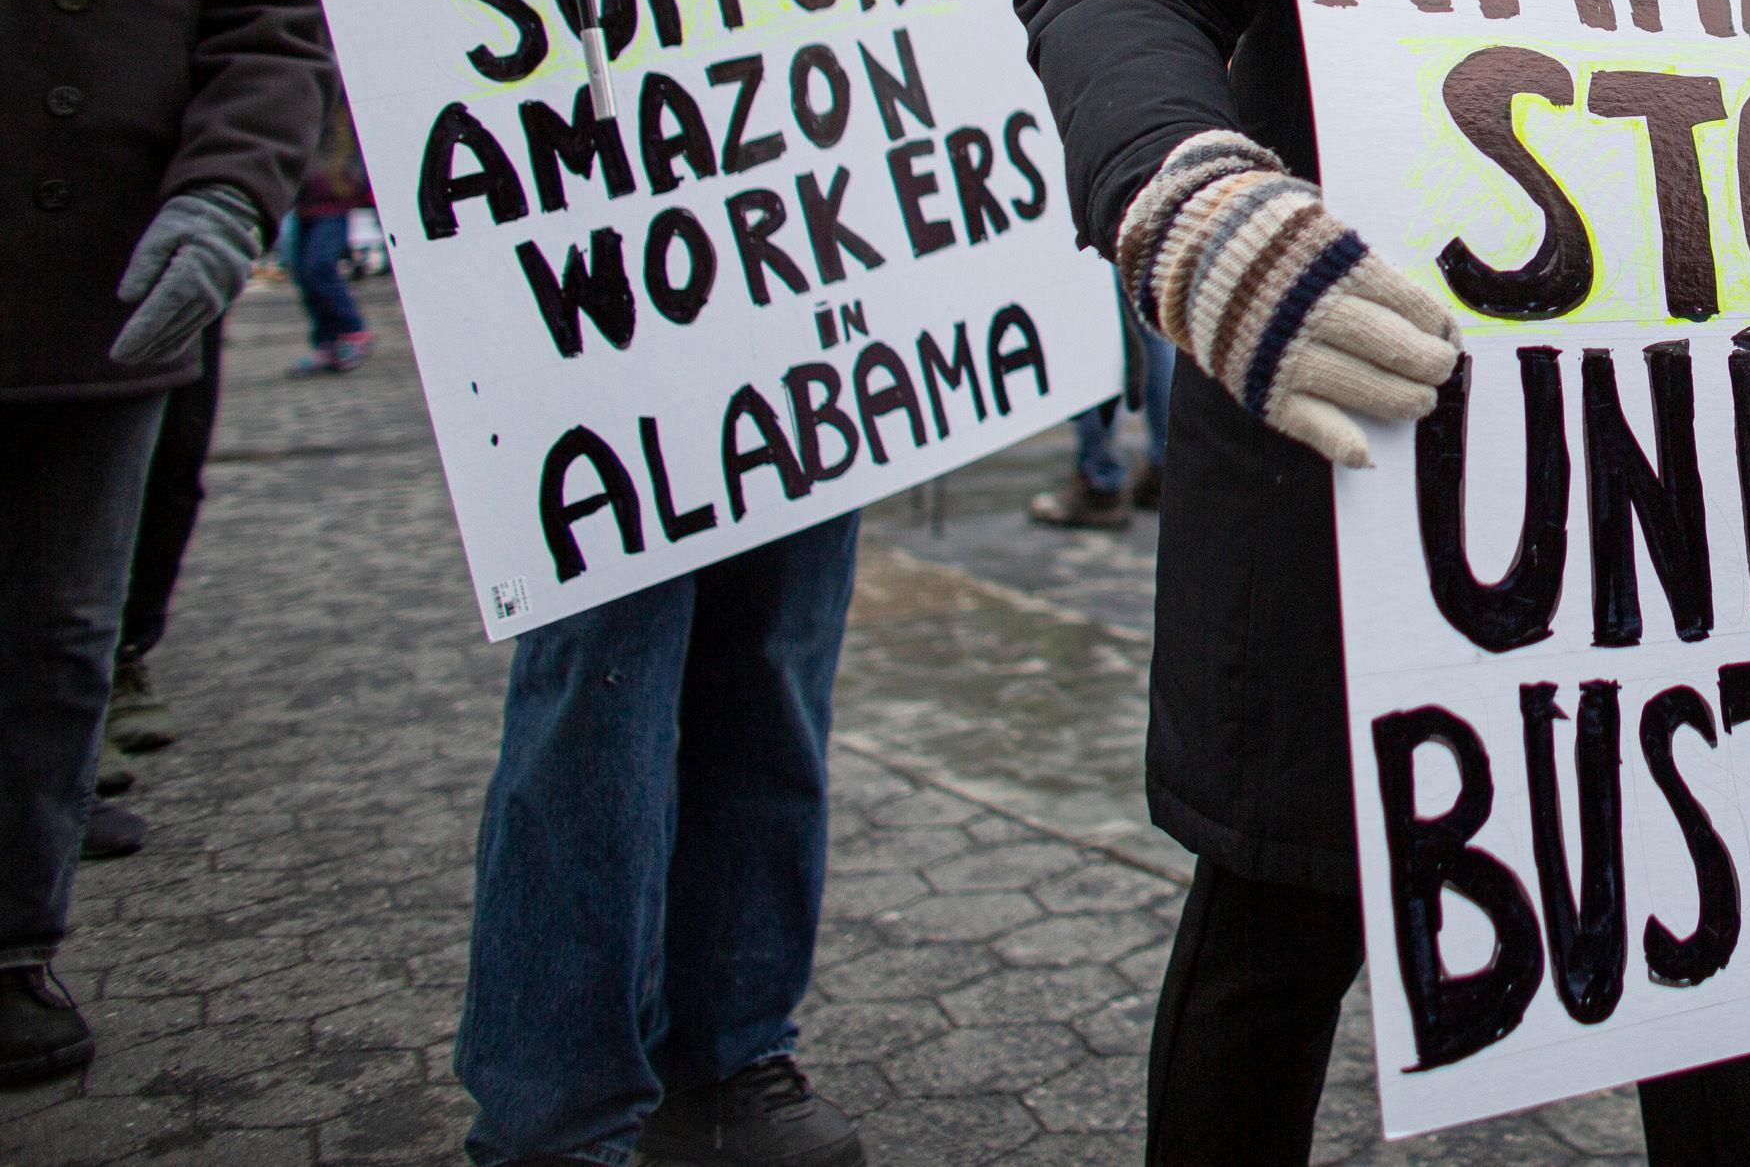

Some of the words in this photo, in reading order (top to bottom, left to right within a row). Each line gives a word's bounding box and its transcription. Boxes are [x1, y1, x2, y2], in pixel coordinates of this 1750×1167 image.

[417, 28, 936, 240] AMAZON
[516, 111, 1047, 357] WORKERS
[539, 304, 1050, 584] ALABAMA
